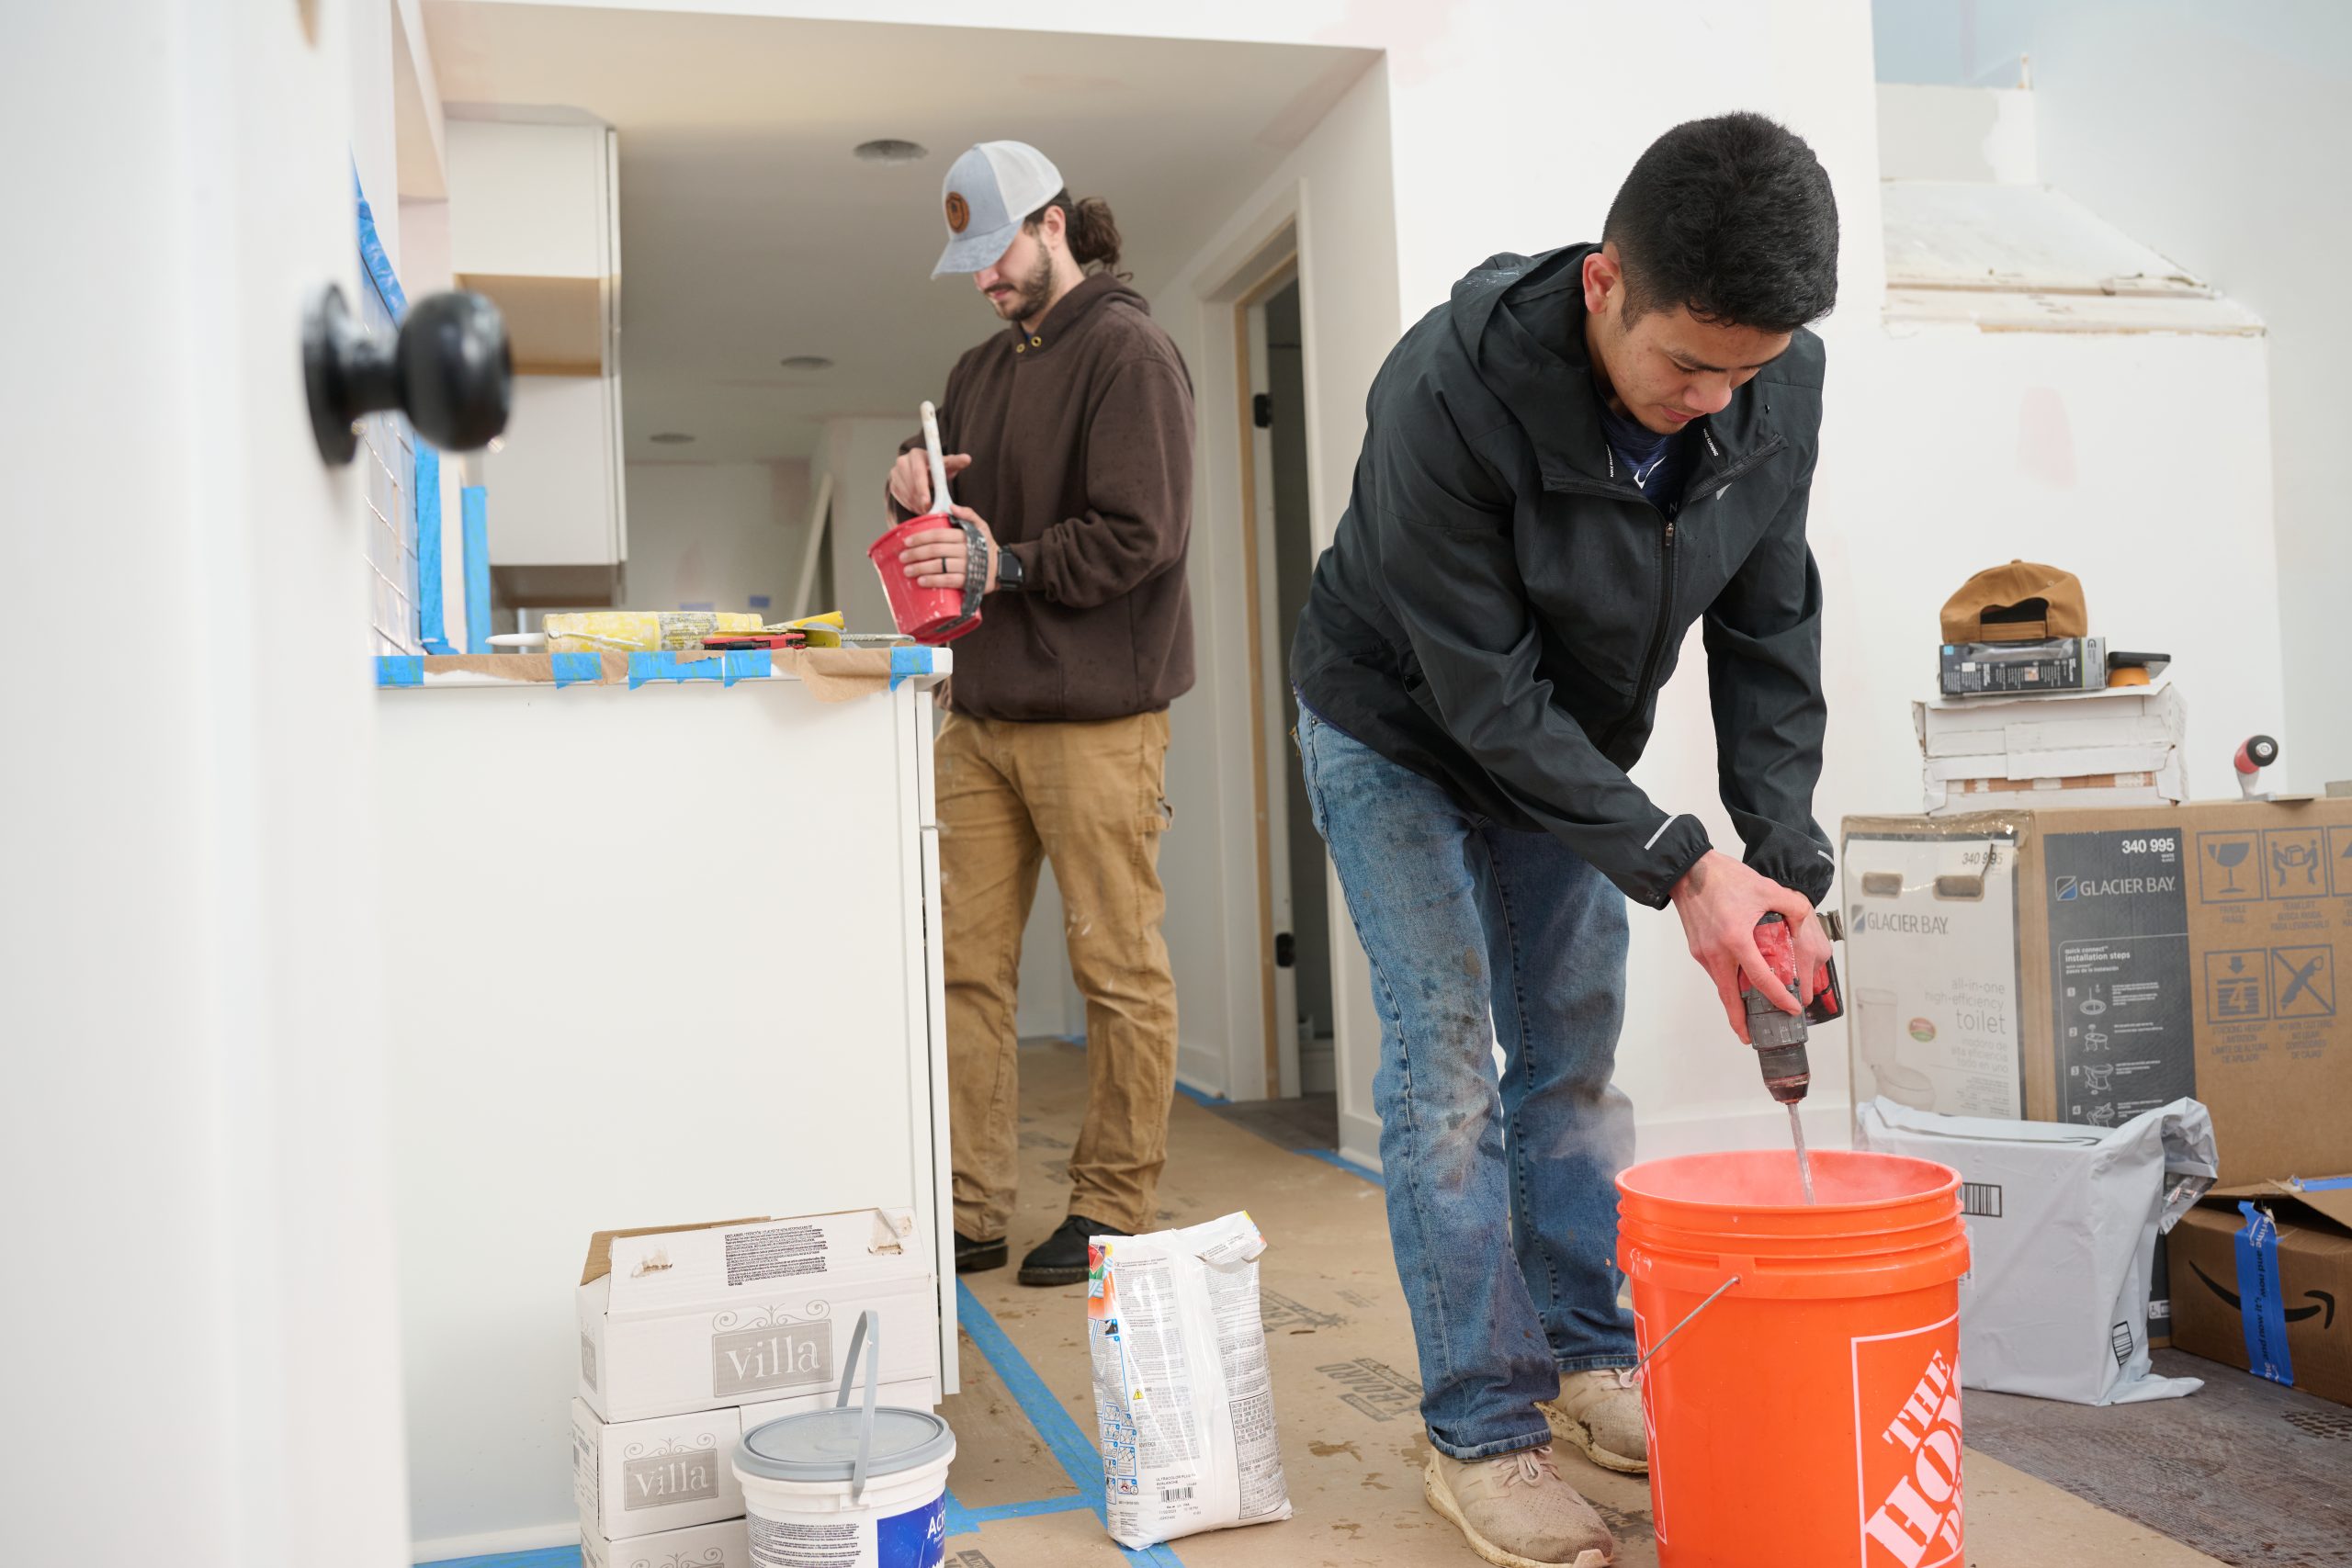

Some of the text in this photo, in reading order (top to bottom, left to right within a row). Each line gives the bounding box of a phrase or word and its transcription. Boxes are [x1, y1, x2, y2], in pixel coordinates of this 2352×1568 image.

[2121, 837, 2176, 854] 340 995
[1962, 852, 1980, 865] 340
[2080, 875, 2176, 897] GLACIER BAY
[1867, 912, 1949, 935] GLACIER BAY
[2065, 952, 2131, 963] installation steps
[1951, 977, 2005, 995] all-in-one
[1925, 992, 2004, 1011] high-efficiency
[1956, 1009, 2007, 1035] toilet
[2256, 1249, 2266, 1272] and
[2256, 1314, 2267, 1339] now
[725, 1335, 821, 1381] villa
[2259, 1340, 2269, 1361] and
[1882, 1349, 1951, 1453] THE
[634, 1461, 709, 1497] villa
